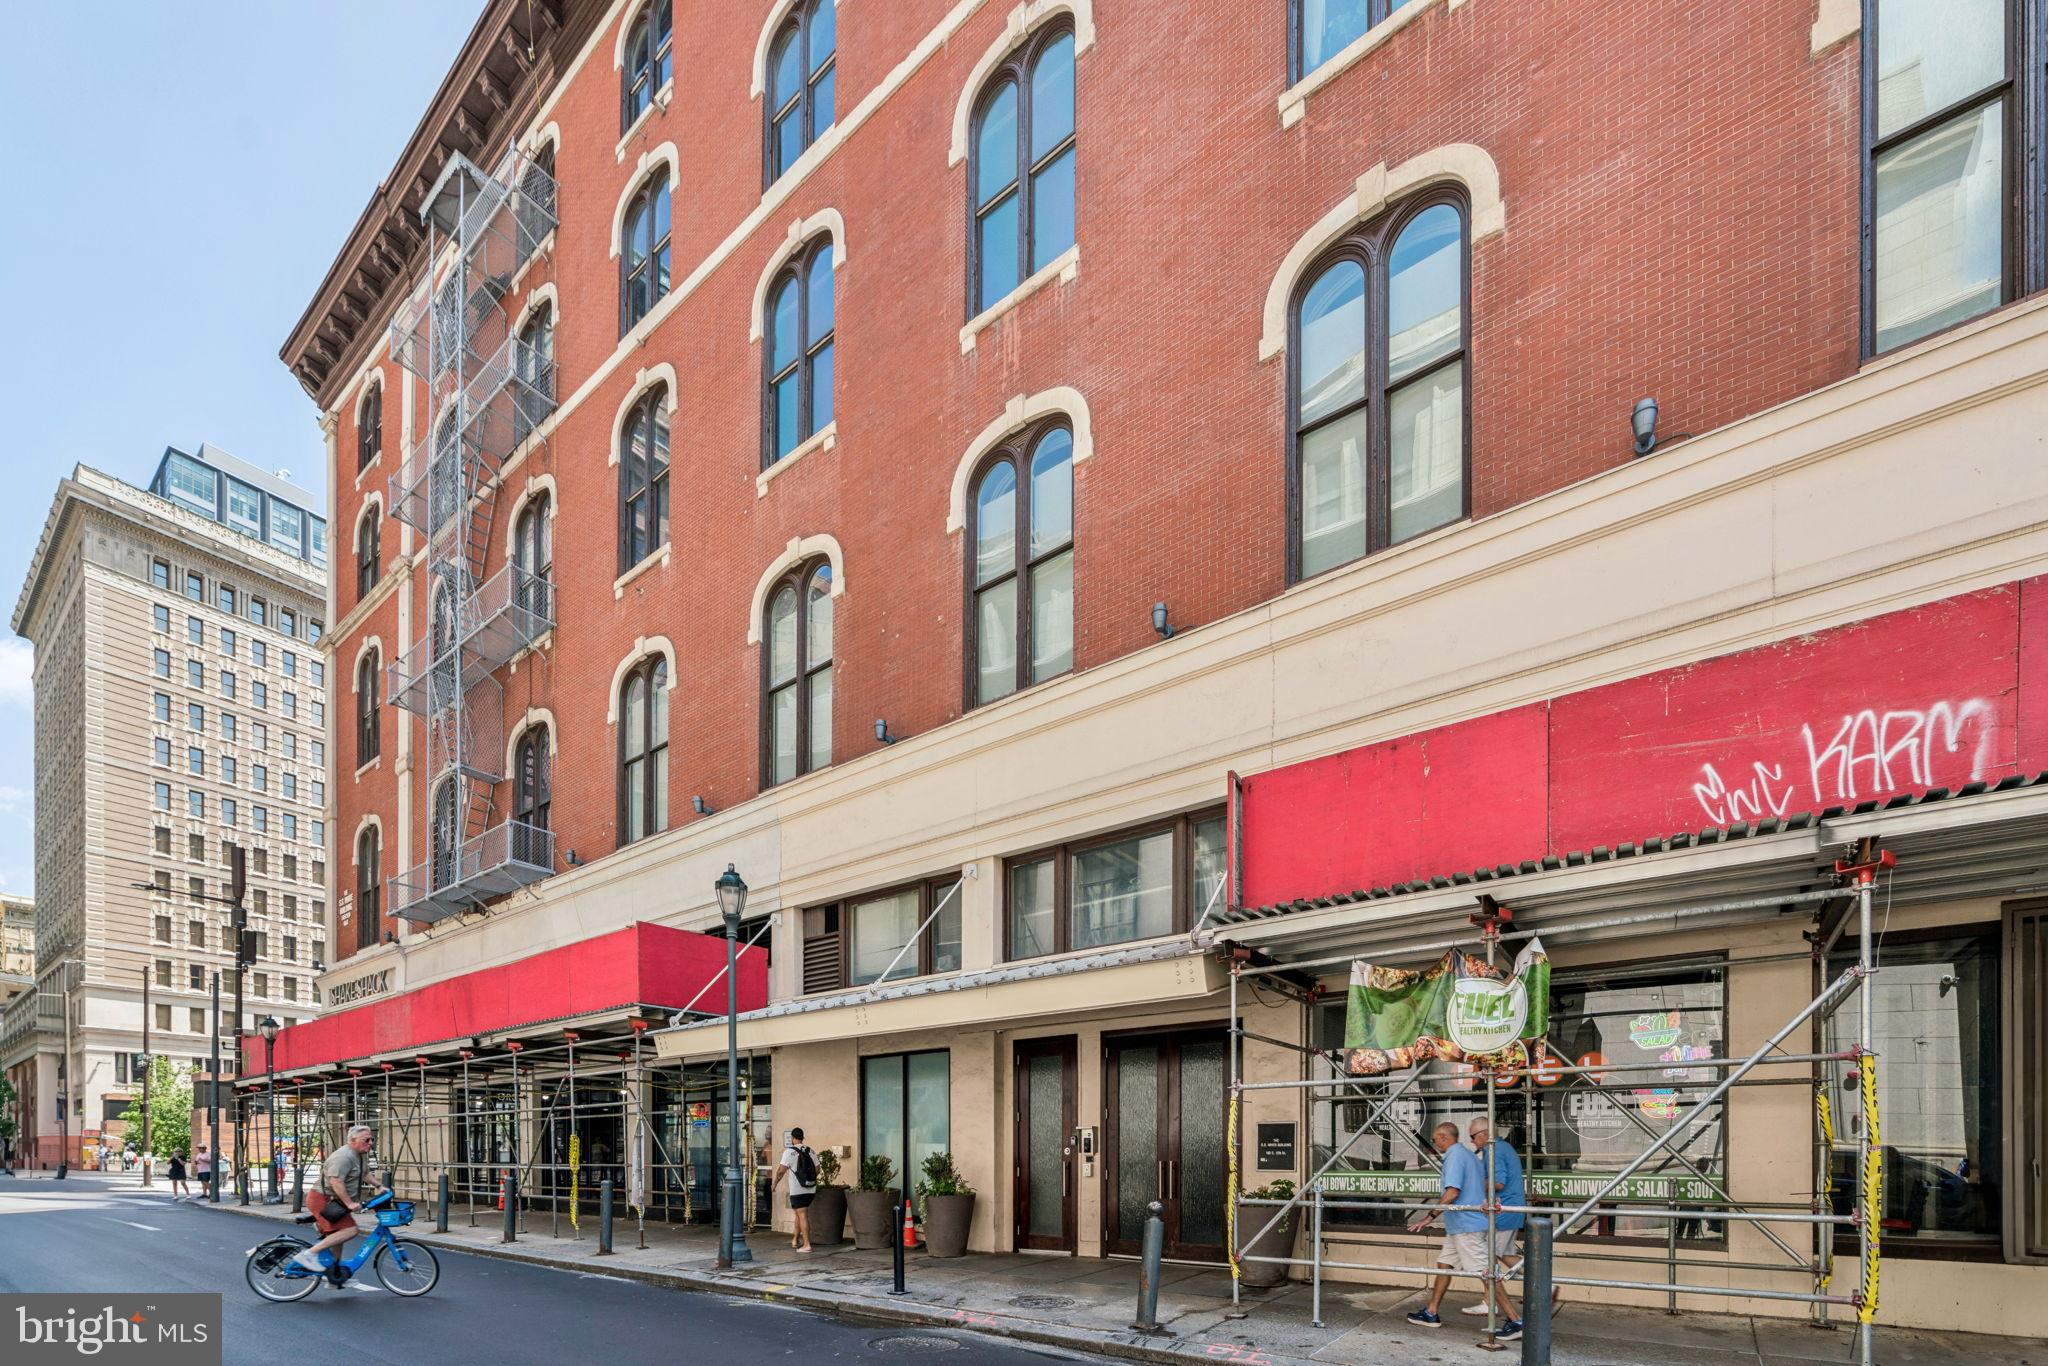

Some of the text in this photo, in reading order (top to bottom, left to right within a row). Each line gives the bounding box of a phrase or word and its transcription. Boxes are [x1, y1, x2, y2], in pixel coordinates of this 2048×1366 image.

[329, 970, 389, 1007] SHAKE SHACK
[1455, 991, 1515, 1022] FUEL
[1458, 1025, 1482, 1036] EALTHY
[1641, 1034, 1672, 1047] SALAD
[1330, 1177, 1356, 1191] BOWLS
[1360, 1177, 1377, 1192] RICE
[1378, 1178, 1405, 1192] BOWLS
